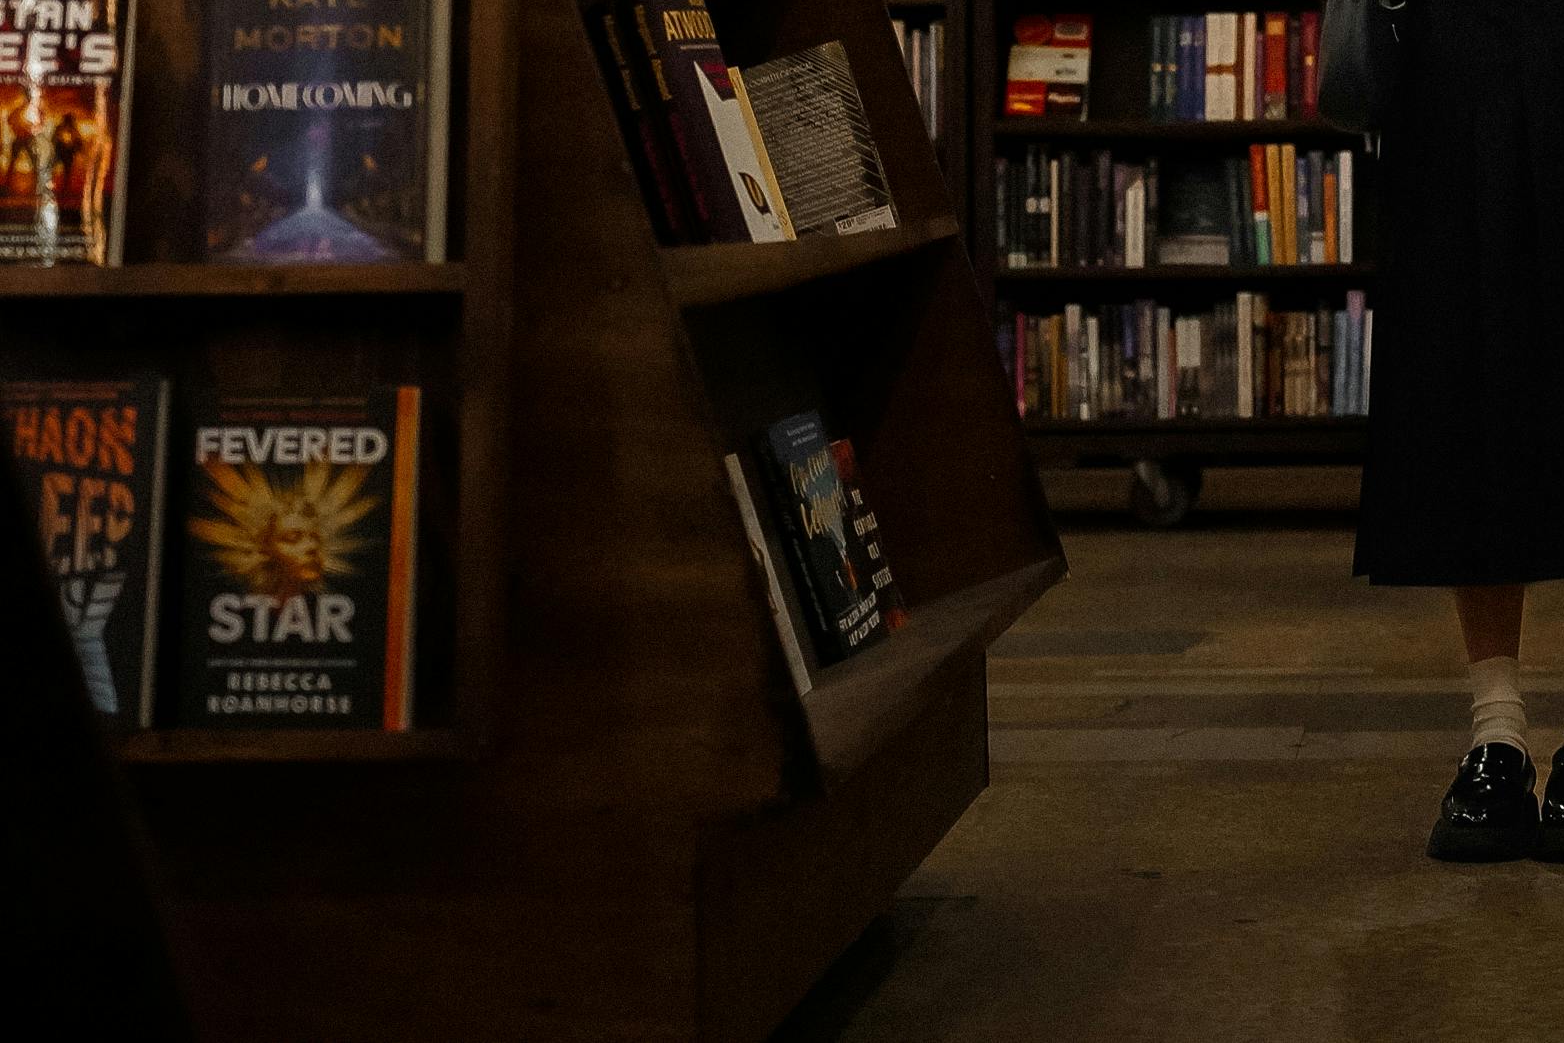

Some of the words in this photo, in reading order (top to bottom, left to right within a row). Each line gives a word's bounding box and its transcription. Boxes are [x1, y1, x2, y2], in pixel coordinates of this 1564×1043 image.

[233, 24, 403, 51] MORTON
[8, 405, 139, 476] HAON
[194, 425, 389, 466] FEVERED
[207, 591, 356, 644] STAR
[226, 672, 332, 692] REBECCA
[206, 695, 353, 715] ROANHORSE
